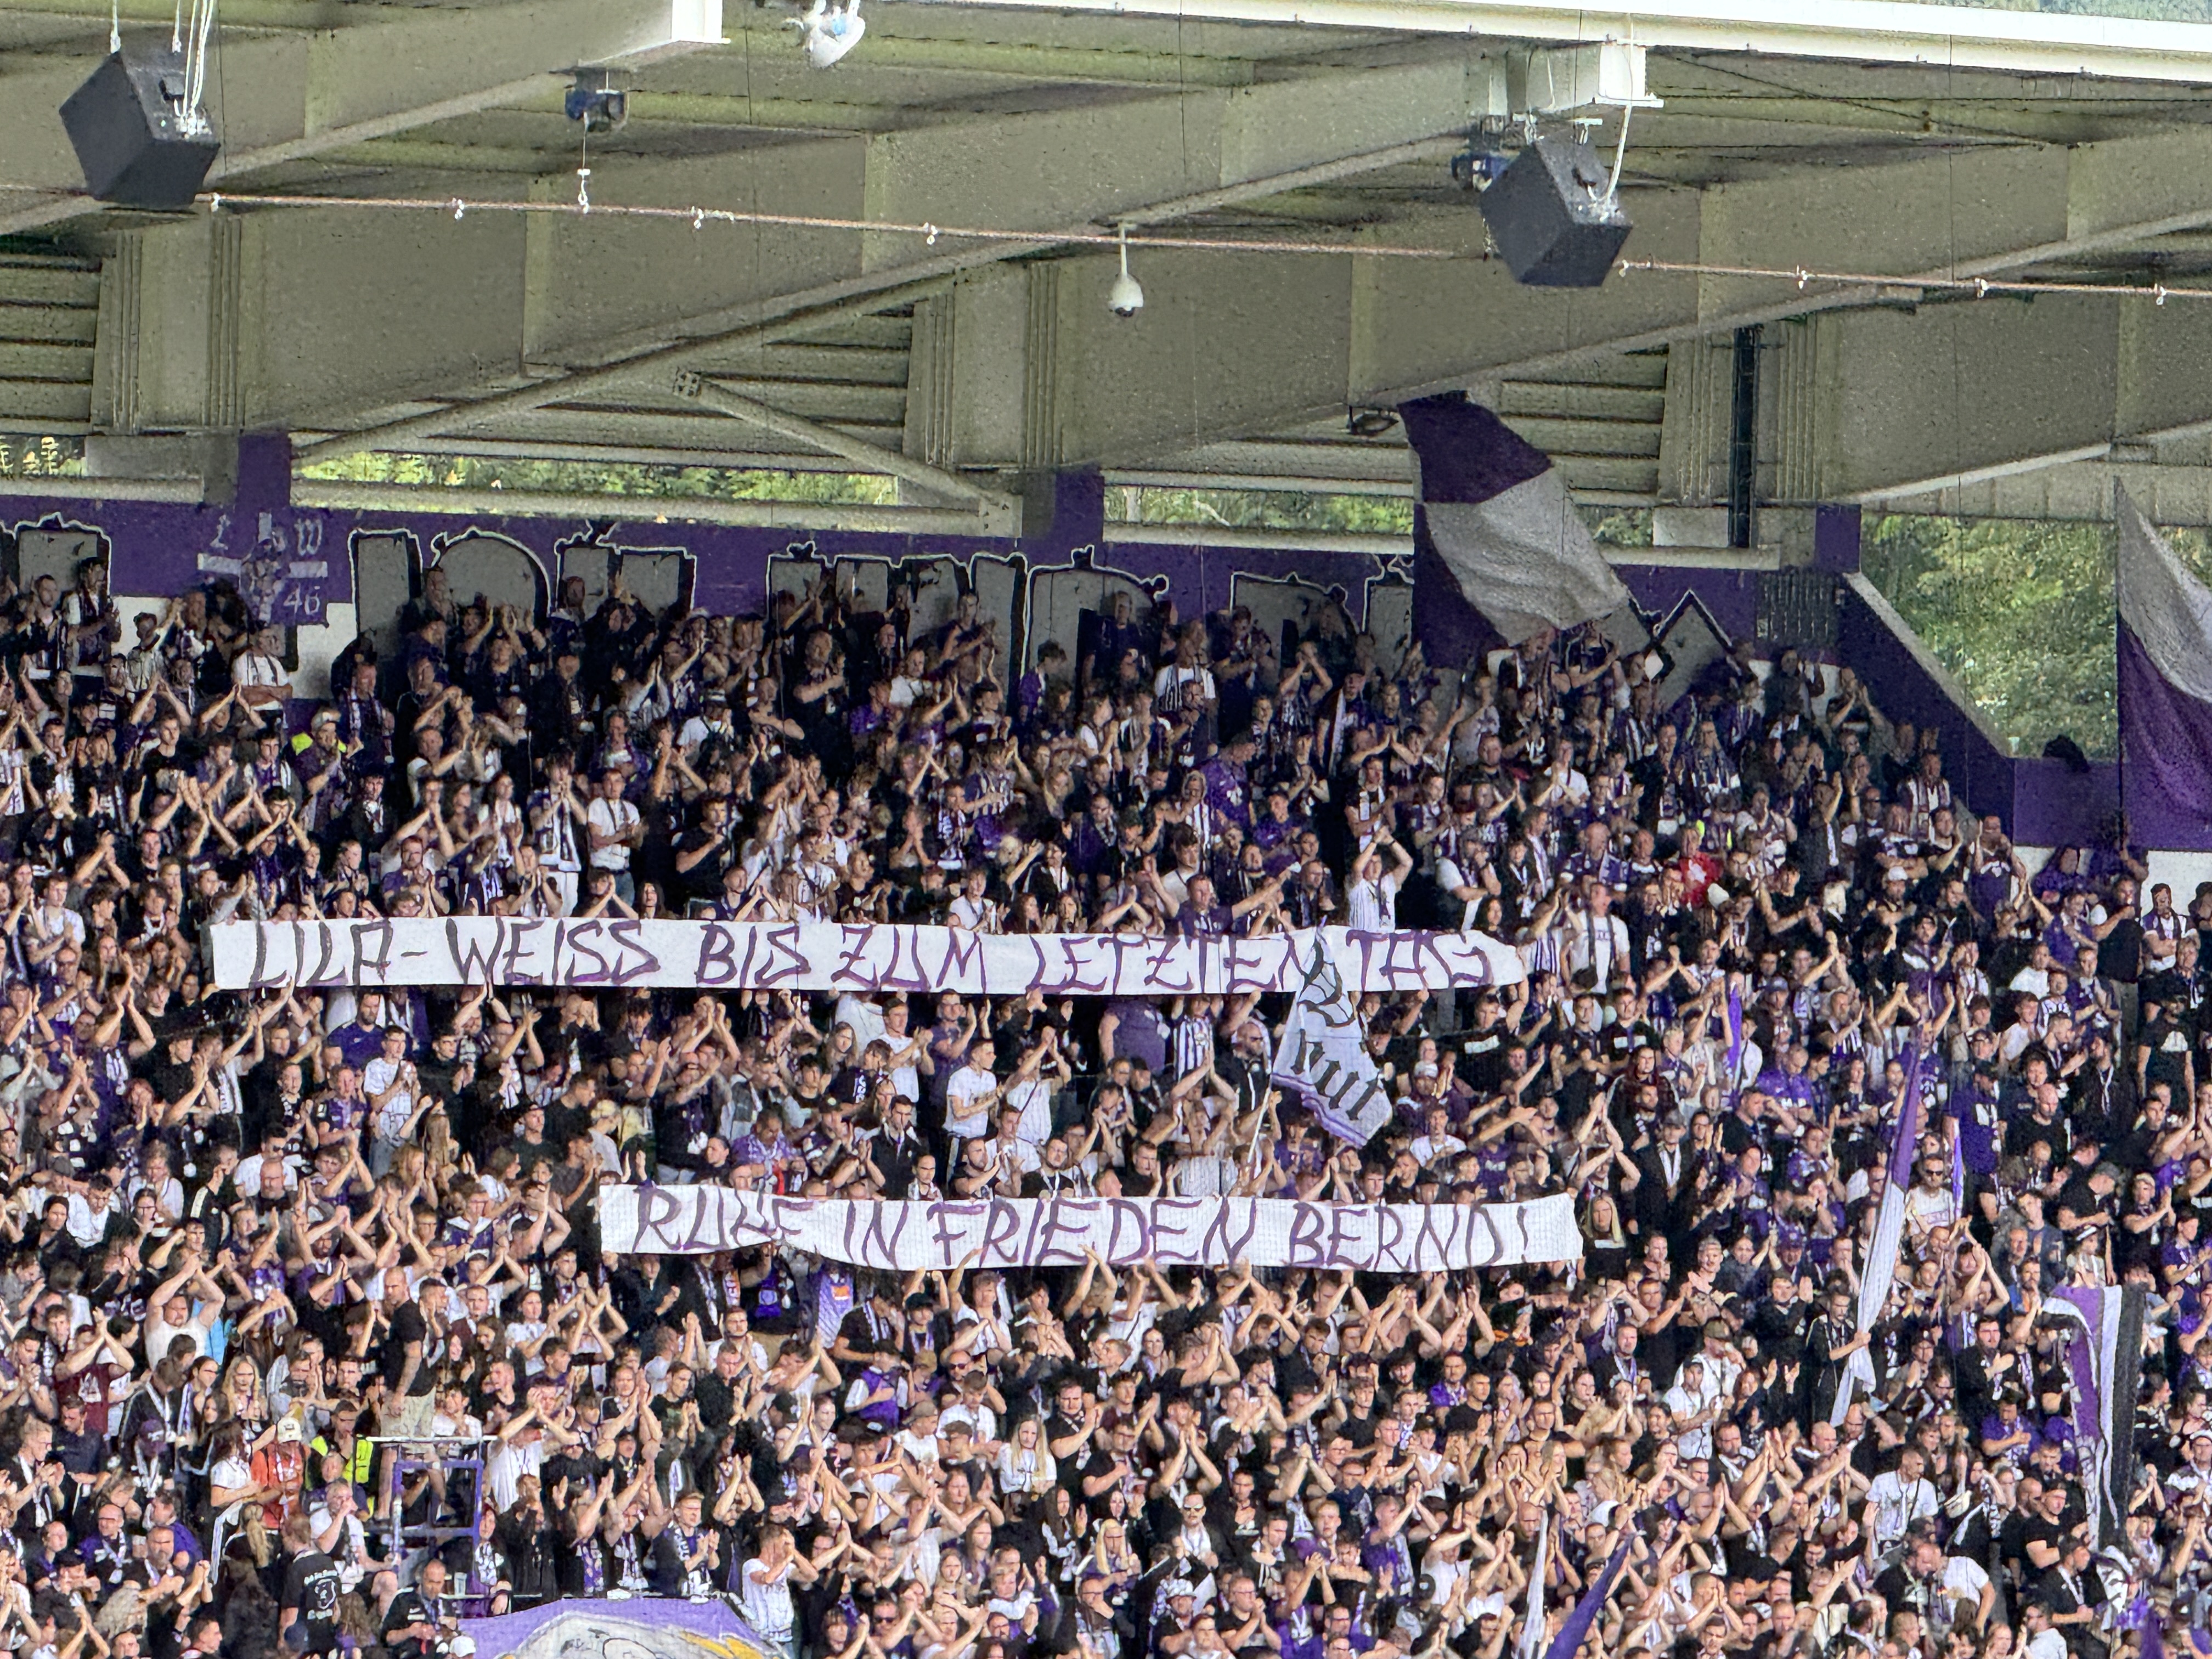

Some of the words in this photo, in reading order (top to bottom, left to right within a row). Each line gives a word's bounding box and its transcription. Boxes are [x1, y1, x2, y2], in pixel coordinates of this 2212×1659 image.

[249, 917, 661, 986] LILA-WEISS
[695, 924, 811, 989] BIS
[831, 924, 987, 994] ZUM
[1346, 930, 1492, 991] TAG
[631, 1185, 814, 1253] RUHE
[844, 1200, 907, 1269] IN
[927, 1197, 1257, 1267] FRIEDEN
[1288, 1198, 1529, 1272] BERND!
